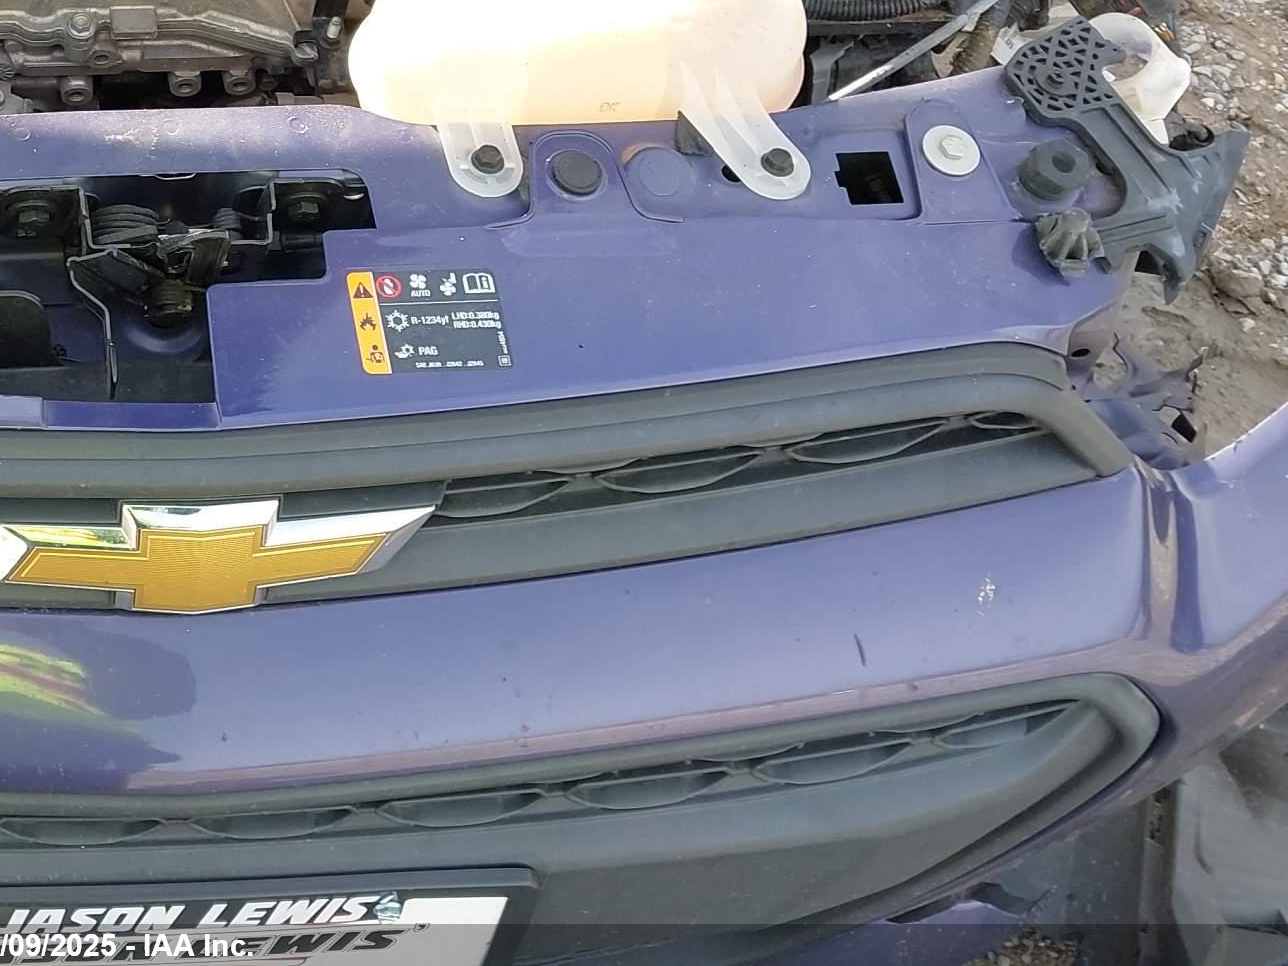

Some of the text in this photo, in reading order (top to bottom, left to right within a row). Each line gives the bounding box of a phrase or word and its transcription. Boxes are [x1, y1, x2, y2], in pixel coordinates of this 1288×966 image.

[410, 289, 432, 298] AUTO
[417, 345, 439, 356] PAG
[196, 896, 382, 930] LEWIS
